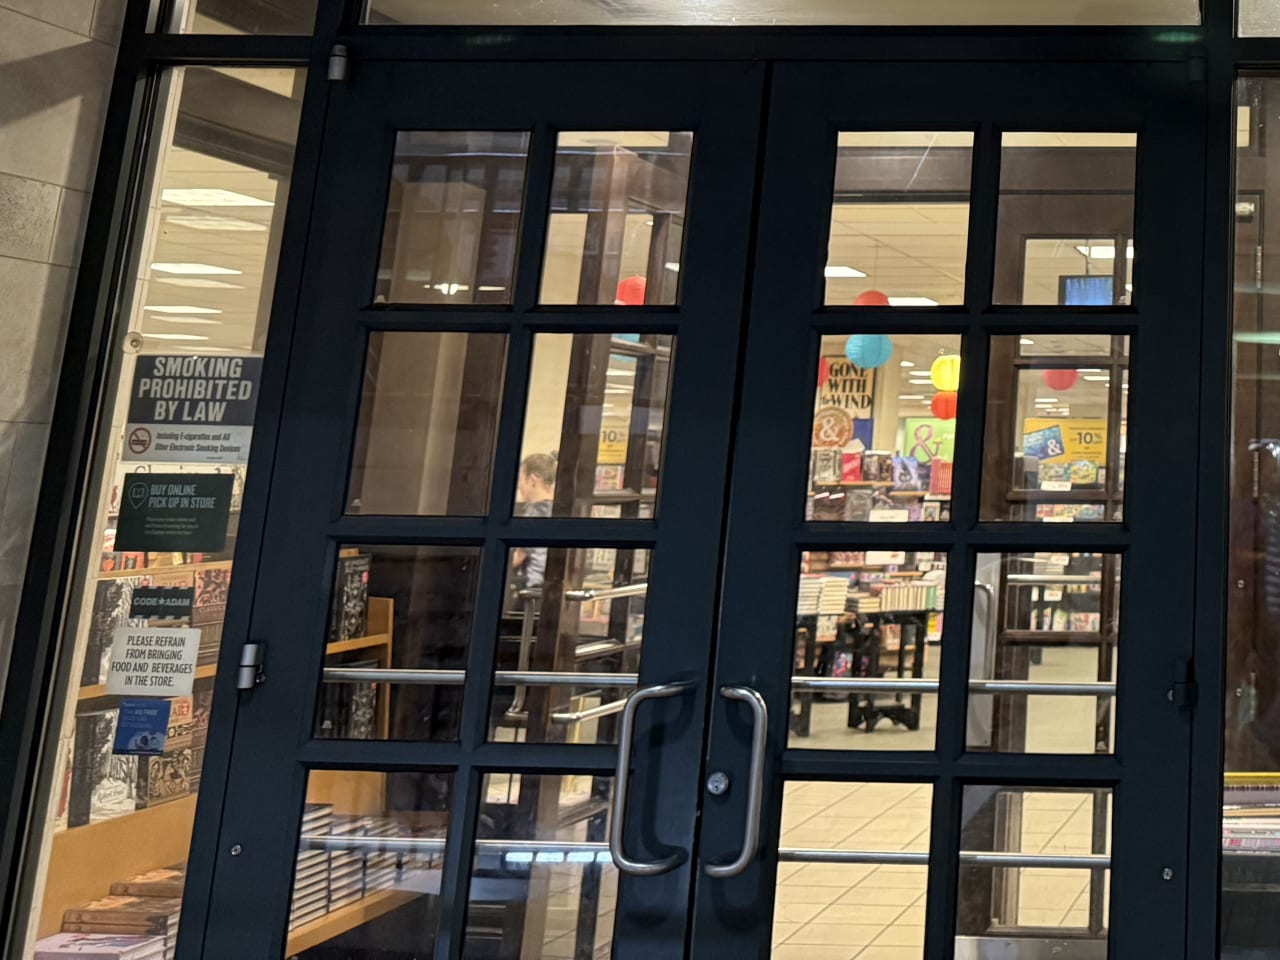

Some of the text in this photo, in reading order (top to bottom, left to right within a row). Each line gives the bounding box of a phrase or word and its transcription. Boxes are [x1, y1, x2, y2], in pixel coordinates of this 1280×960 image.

[153, 356, 243, 378] SMOKING
[138, 378, 253, 400] PROHIBITED
[828, 378, 868, 394] WITH
[830, 395, 872, 410] WIND
[154, 400, 227, 422] BY LAW
[150, 484, 198, 497] BUY ONLINE
[148, 496, 217, 509] PICK UP IN STORE
[133, 596, 191, 607] CODE ADAM
[127, 635, 187, 648] PLEASE REFRAIN
[125, 648, 183, 661] FROM BRINGING
[111, 661, 193, 674] FOOD AND BEVERAGES
[124, 675, 135, 686] IN
[135, 675, 149, 687] THE
